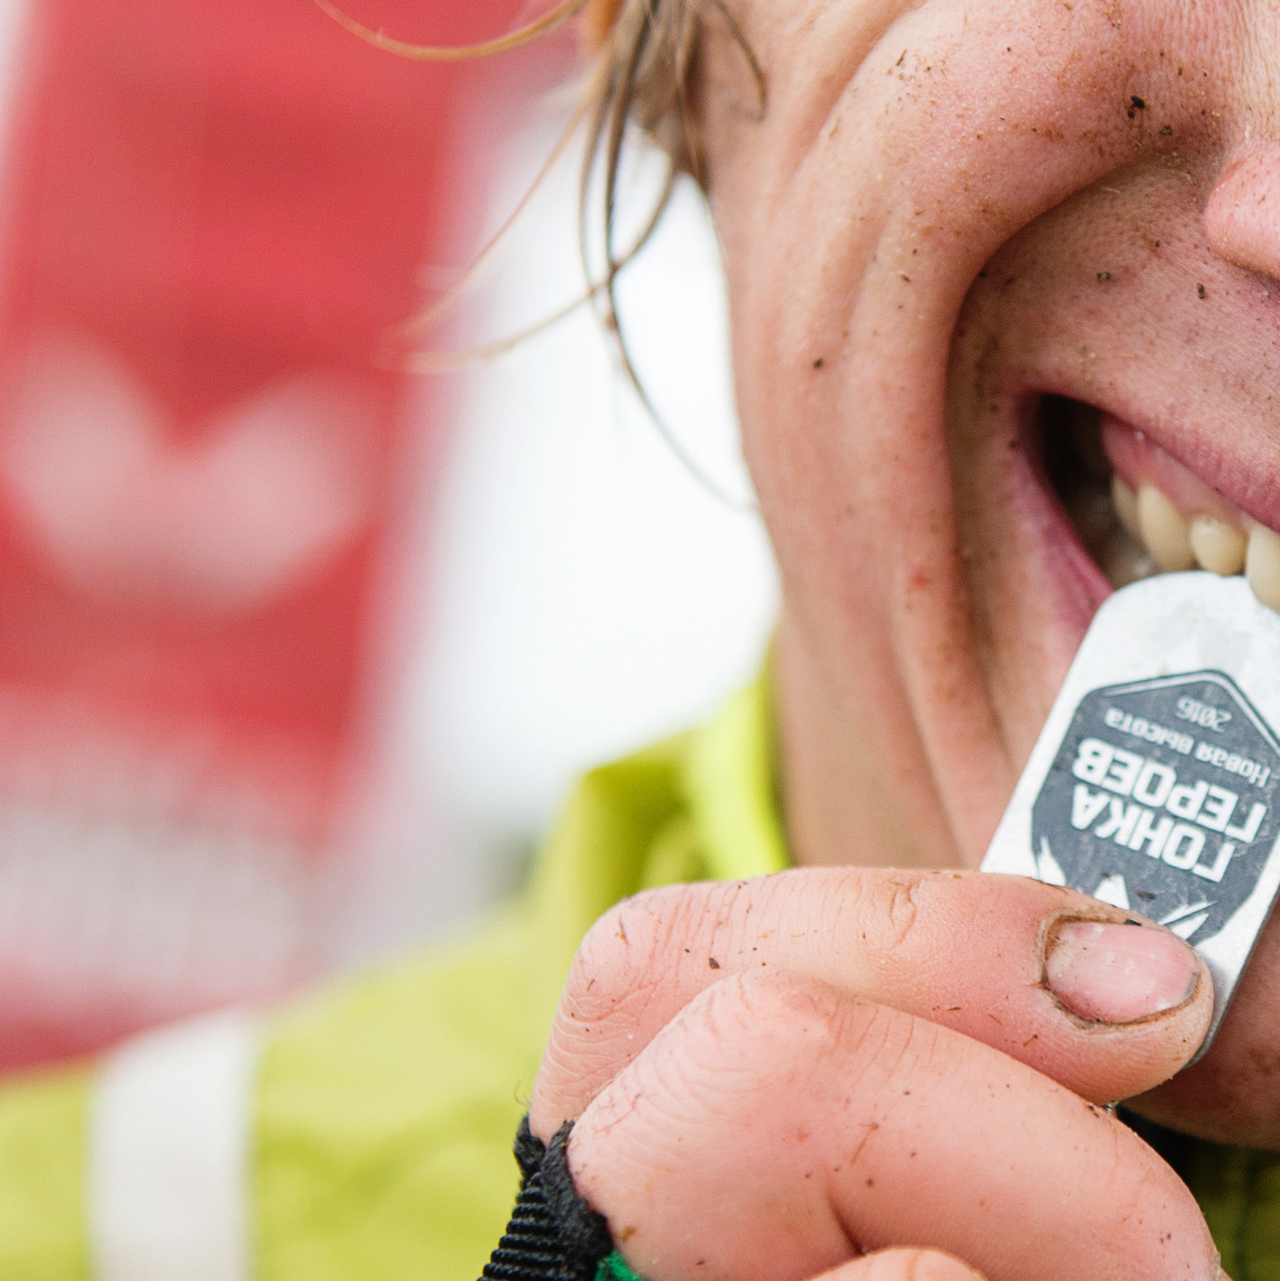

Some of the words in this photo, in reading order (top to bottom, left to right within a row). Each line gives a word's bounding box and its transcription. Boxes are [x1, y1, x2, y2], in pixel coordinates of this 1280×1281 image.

[1104, 707, 1195, 755] высота
[1175, 695, 1232, 733] 2016
[1194, 741, 1271, 788] Новая
[1072, 737, 1268, 844] ГЕРОЕВ
[1071, 783, 1235, 883] ГОНКА
